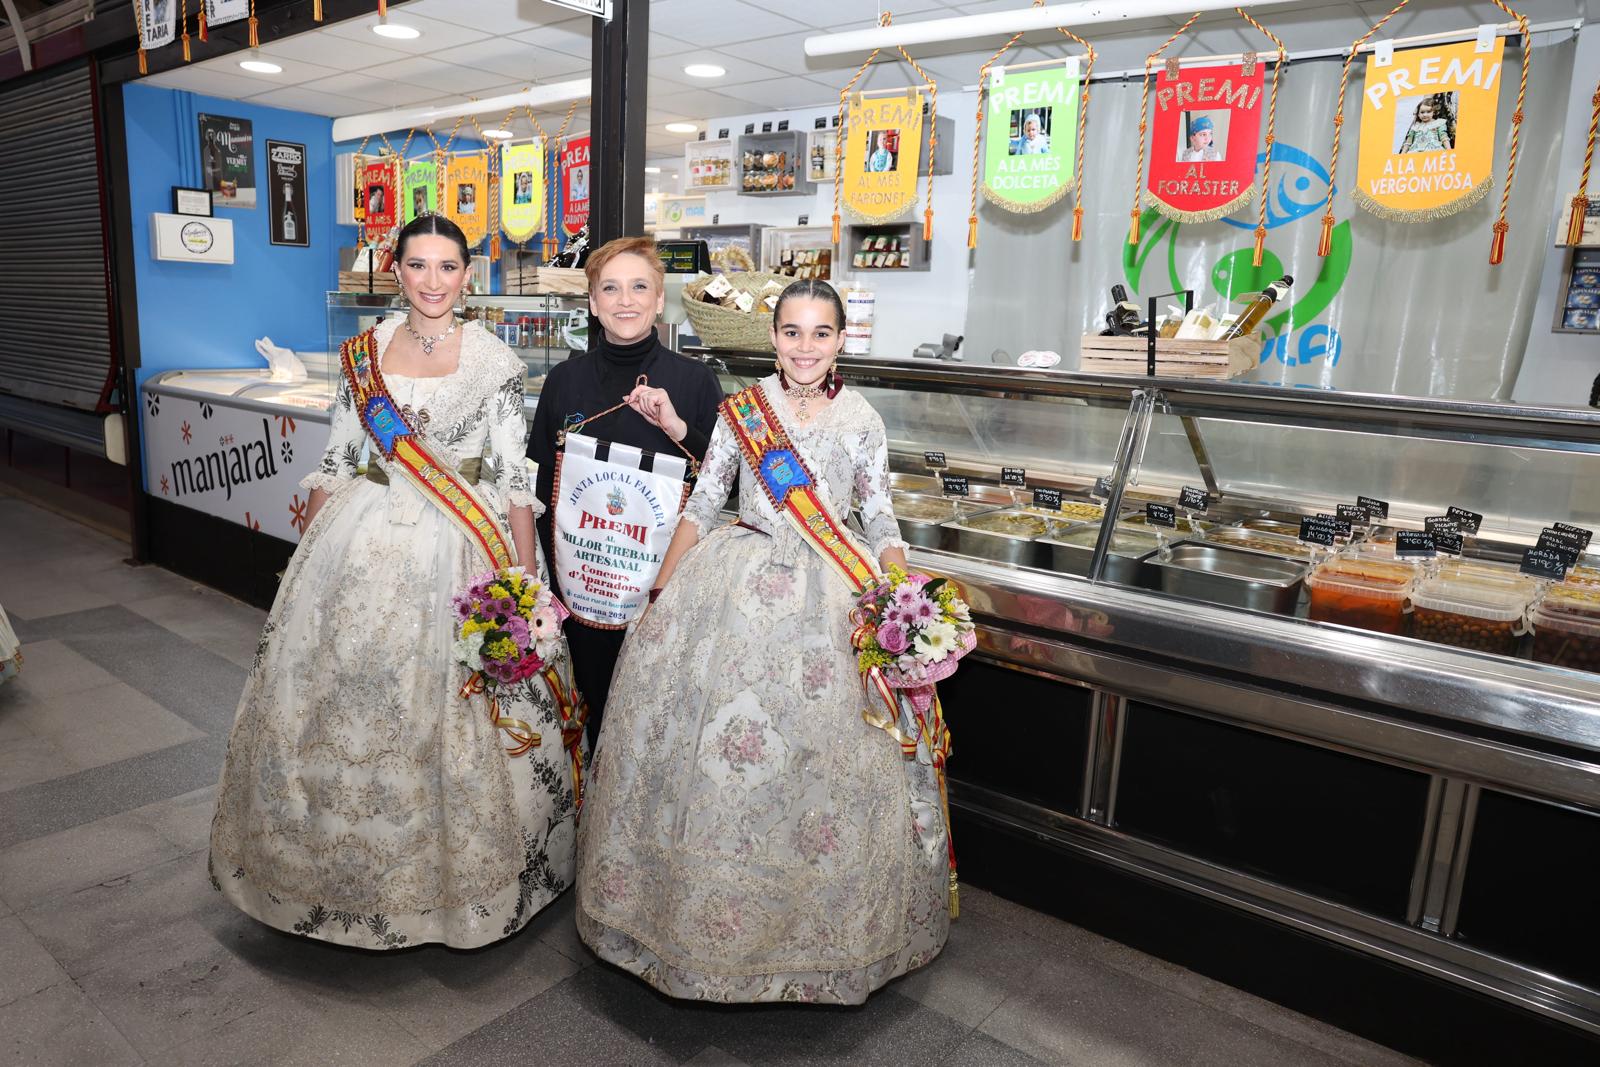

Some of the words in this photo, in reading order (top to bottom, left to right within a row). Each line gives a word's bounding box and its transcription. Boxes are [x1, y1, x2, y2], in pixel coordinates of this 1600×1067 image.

[1365, 57, 1500, 110] PREMI
[990, 80, 1078, 113] PREMI
[1157, 78, 1261, 111] PREMI
[850, 103, 921, 132] PREMI
[998, 159, 1009, 171] A
[1010, 158, 1031, 171] LA
[1185, 165, 1207, 179] AL
[1384, 159, 1393, 174] A
[1397, 157, 1415, 173] LA
[1423, 153, 1456, 172] MÉS
[448, 166, 486, 184] PREMI
[858, 176, 871, 188] AL
[992, 173, 1059, 190] DOLCETA
[1370, 172, 1473, 196] VERGONYOSA
[1158, 180, 1240, 196] FORASTER
[171, 418, 278, 501] manjaral
[569, 478, 594, 506] JUNTA
[595, 471, 631, 485] LOCAL
[634, 480, 665, 528] FALLERA
[1451, 508, 1473, 517] PERLA
[578, 510, 648, 545] PREMI
[562, 531, 602, 552] MILLOR
[606, 544, 660, 563] TREBALL
[606, 535, 615, 543] AL
[574, 549, 642, 572] ARTESANAL
[568, 570, 641, 593] d'Aparadors
[581, 564, 630, 582] Concurs
[573, 592, 590, 601] caixa
[591, 597, 607, 606] rural
[585, 584, 620, 599] Grans
[572, 602, 606, 616] Burriana
[609, 611, 626, 620] 2024
